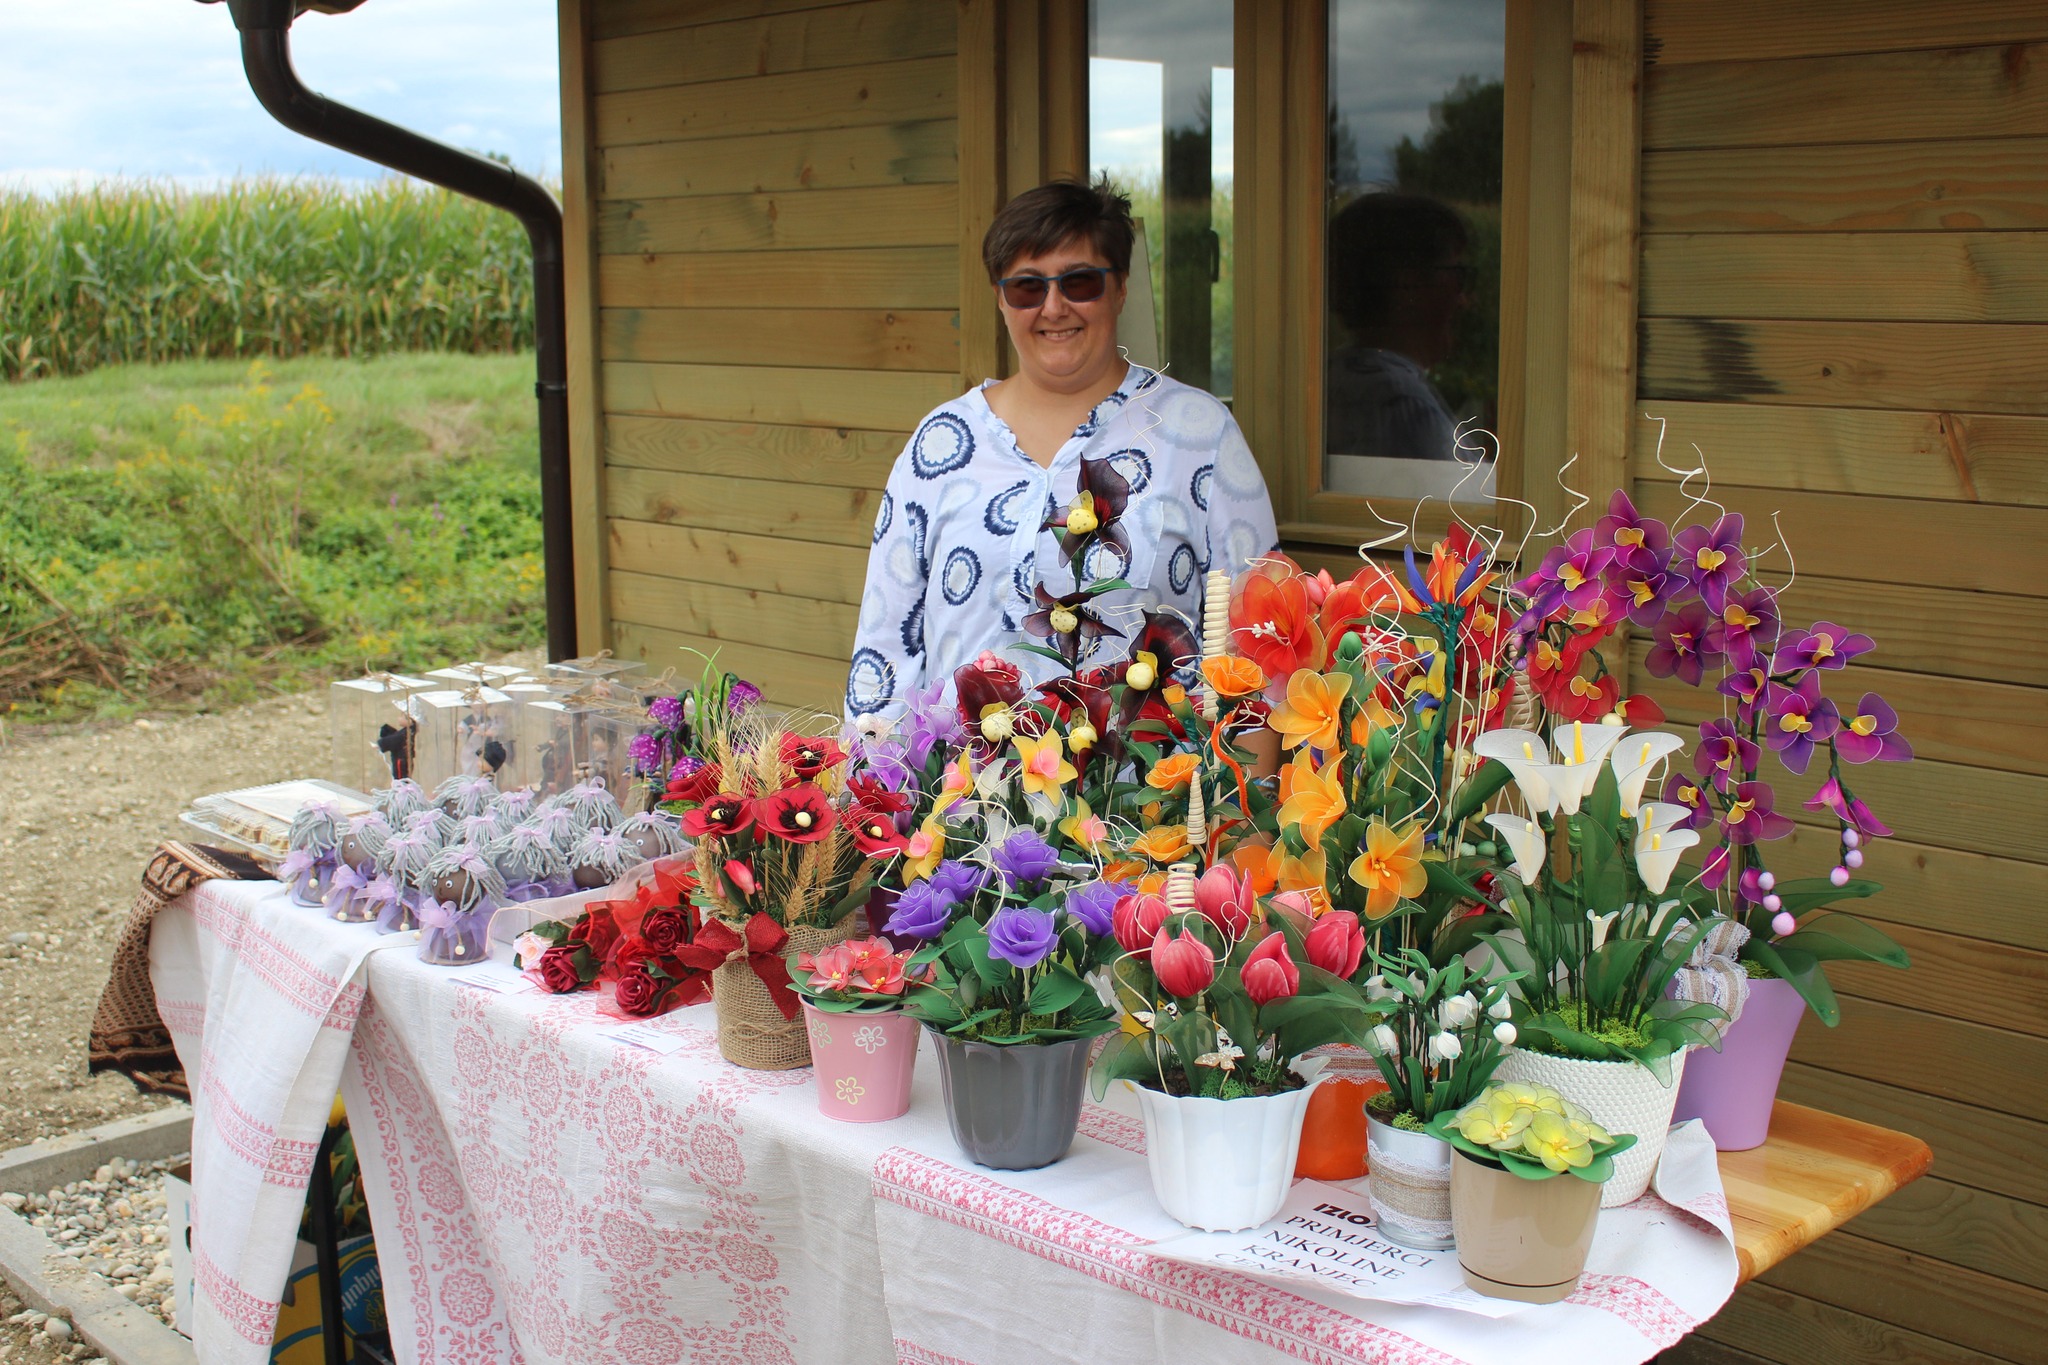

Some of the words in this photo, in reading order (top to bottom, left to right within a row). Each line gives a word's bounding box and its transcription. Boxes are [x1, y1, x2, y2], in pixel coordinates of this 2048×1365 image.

[1312, 1202, 1377, 1230] IZLO
[1262, 1229, 1406, 1280] NIKOLINE
[1283, 1215, 1435, 1268] PRIMJERCI
[1242, 1244, 1377, 1288] KRANJEC
